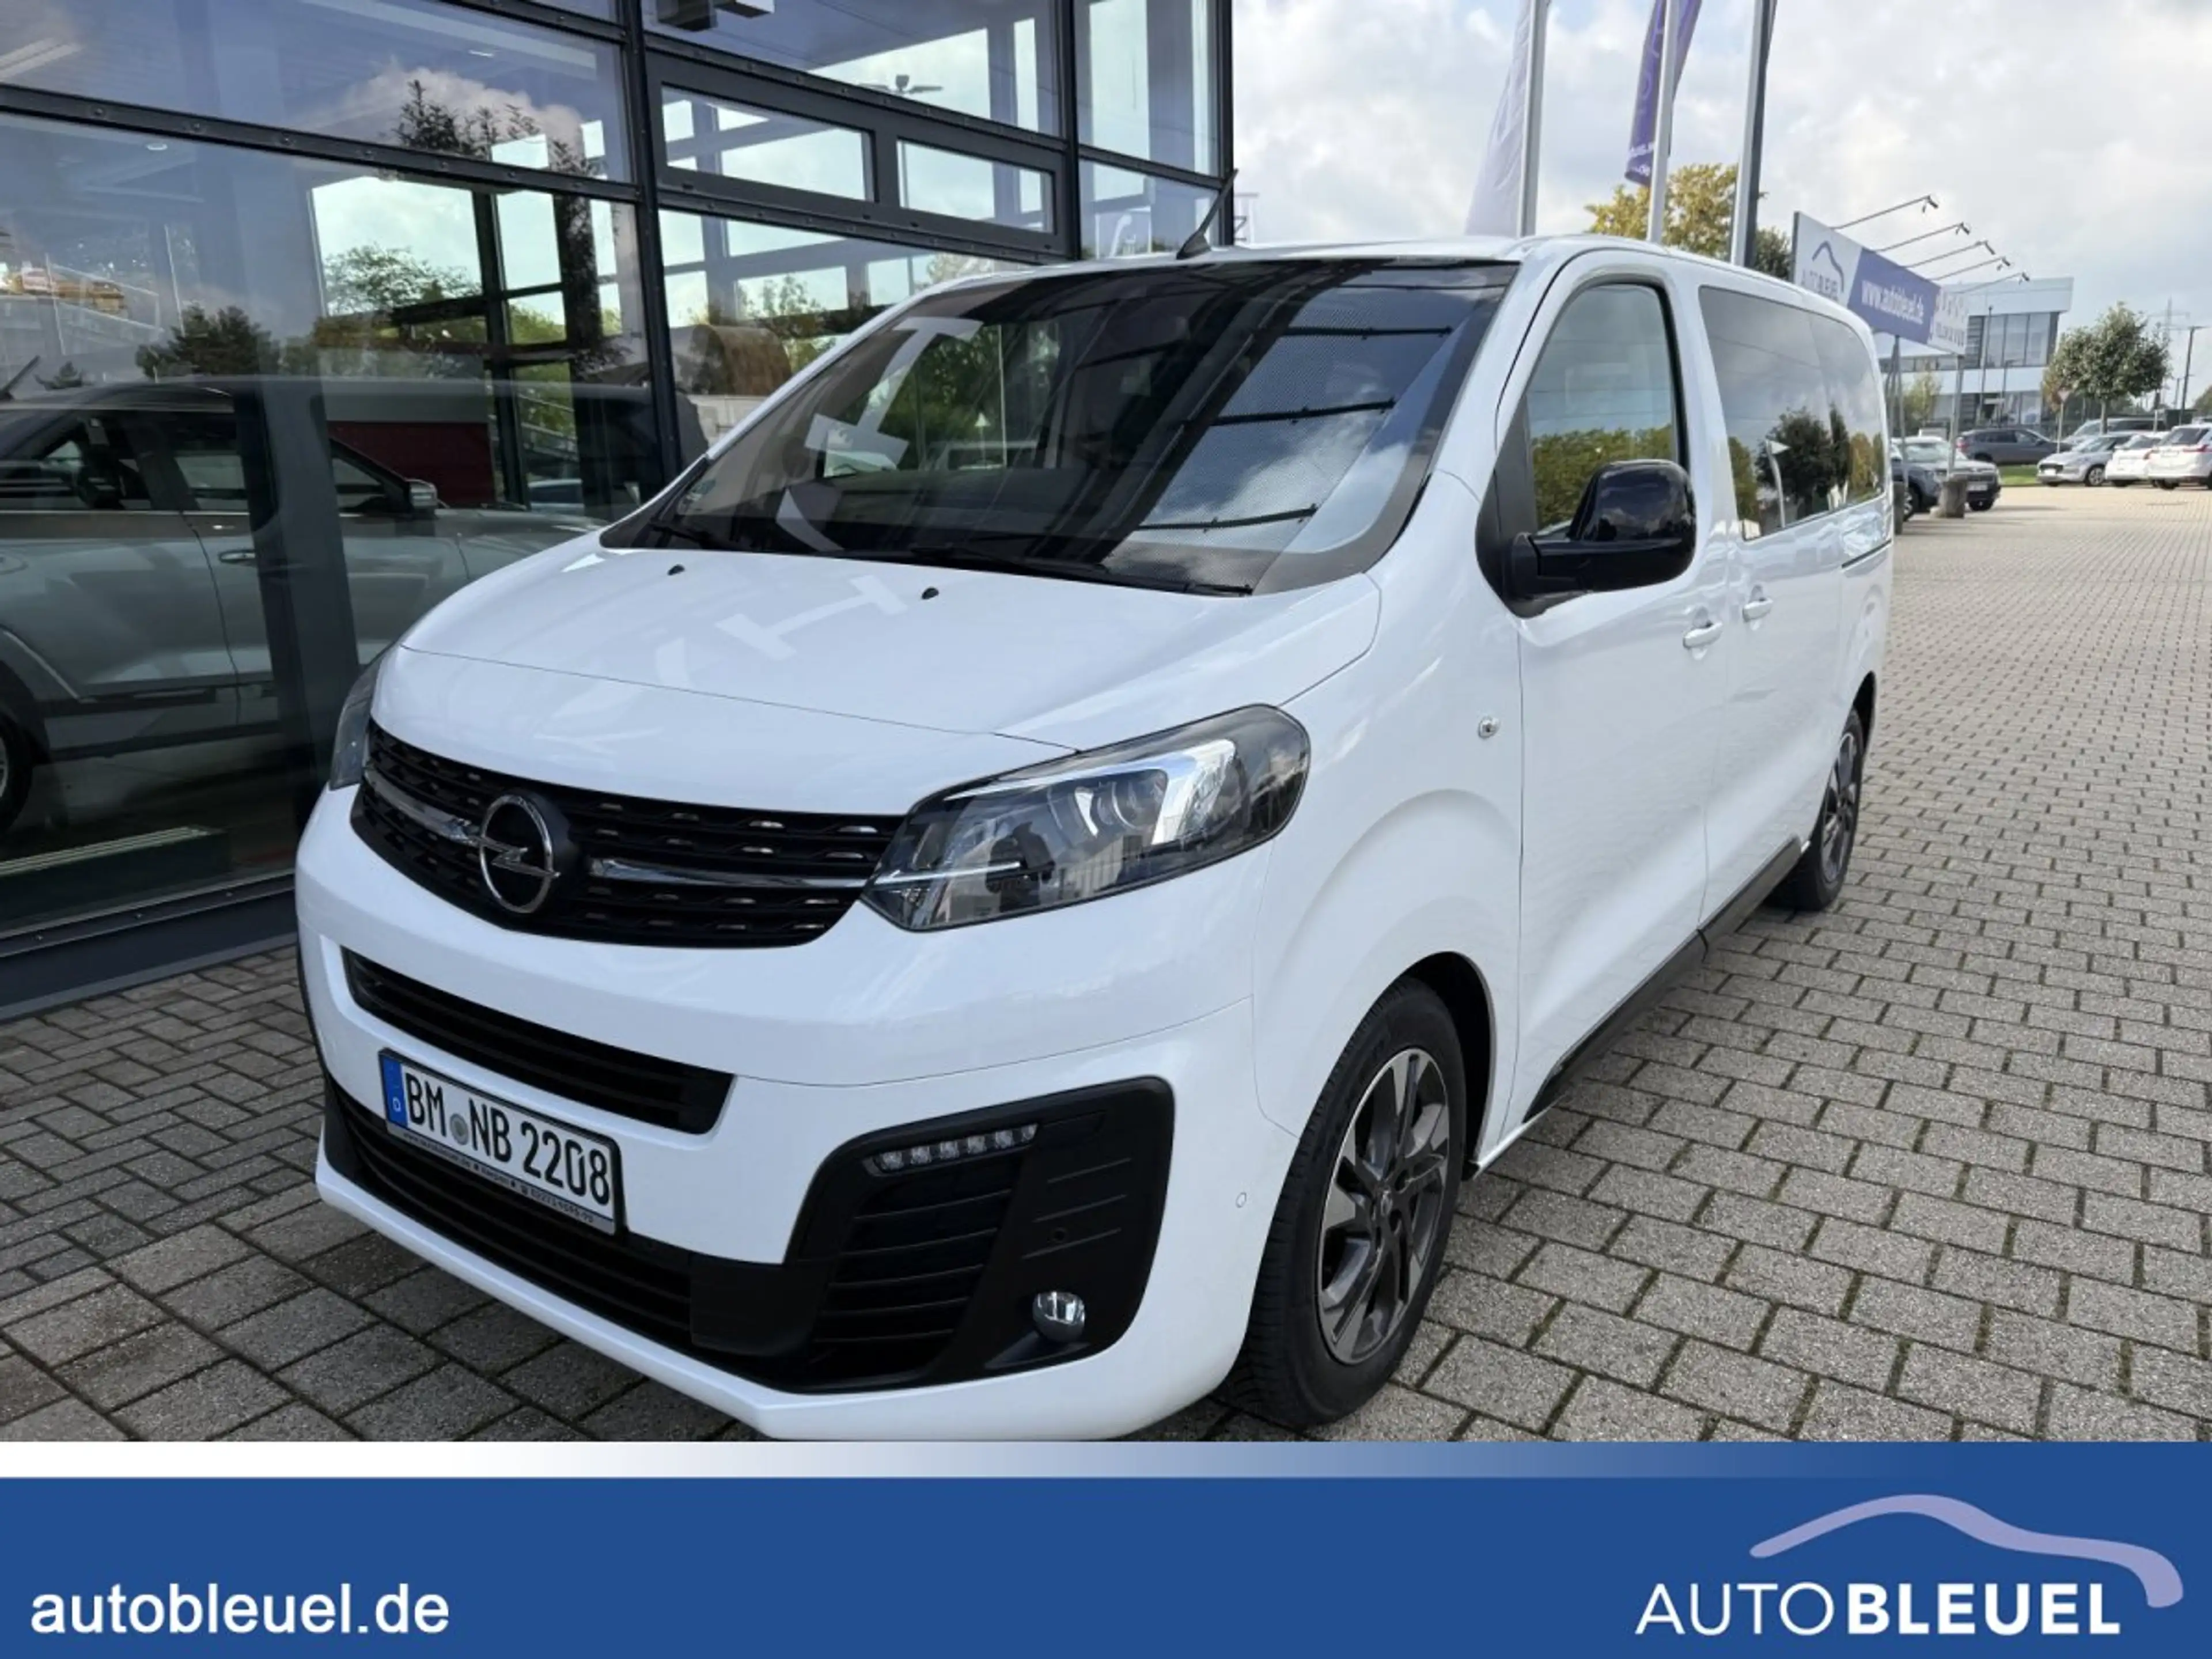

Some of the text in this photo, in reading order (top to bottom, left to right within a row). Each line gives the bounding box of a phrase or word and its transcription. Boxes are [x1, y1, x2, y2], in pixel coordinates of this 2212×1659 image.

[405, 1073, 447, 1137] BM
[469, 1097, 513, 1163] NB
[520, 1121, 610, 1206] 2208
